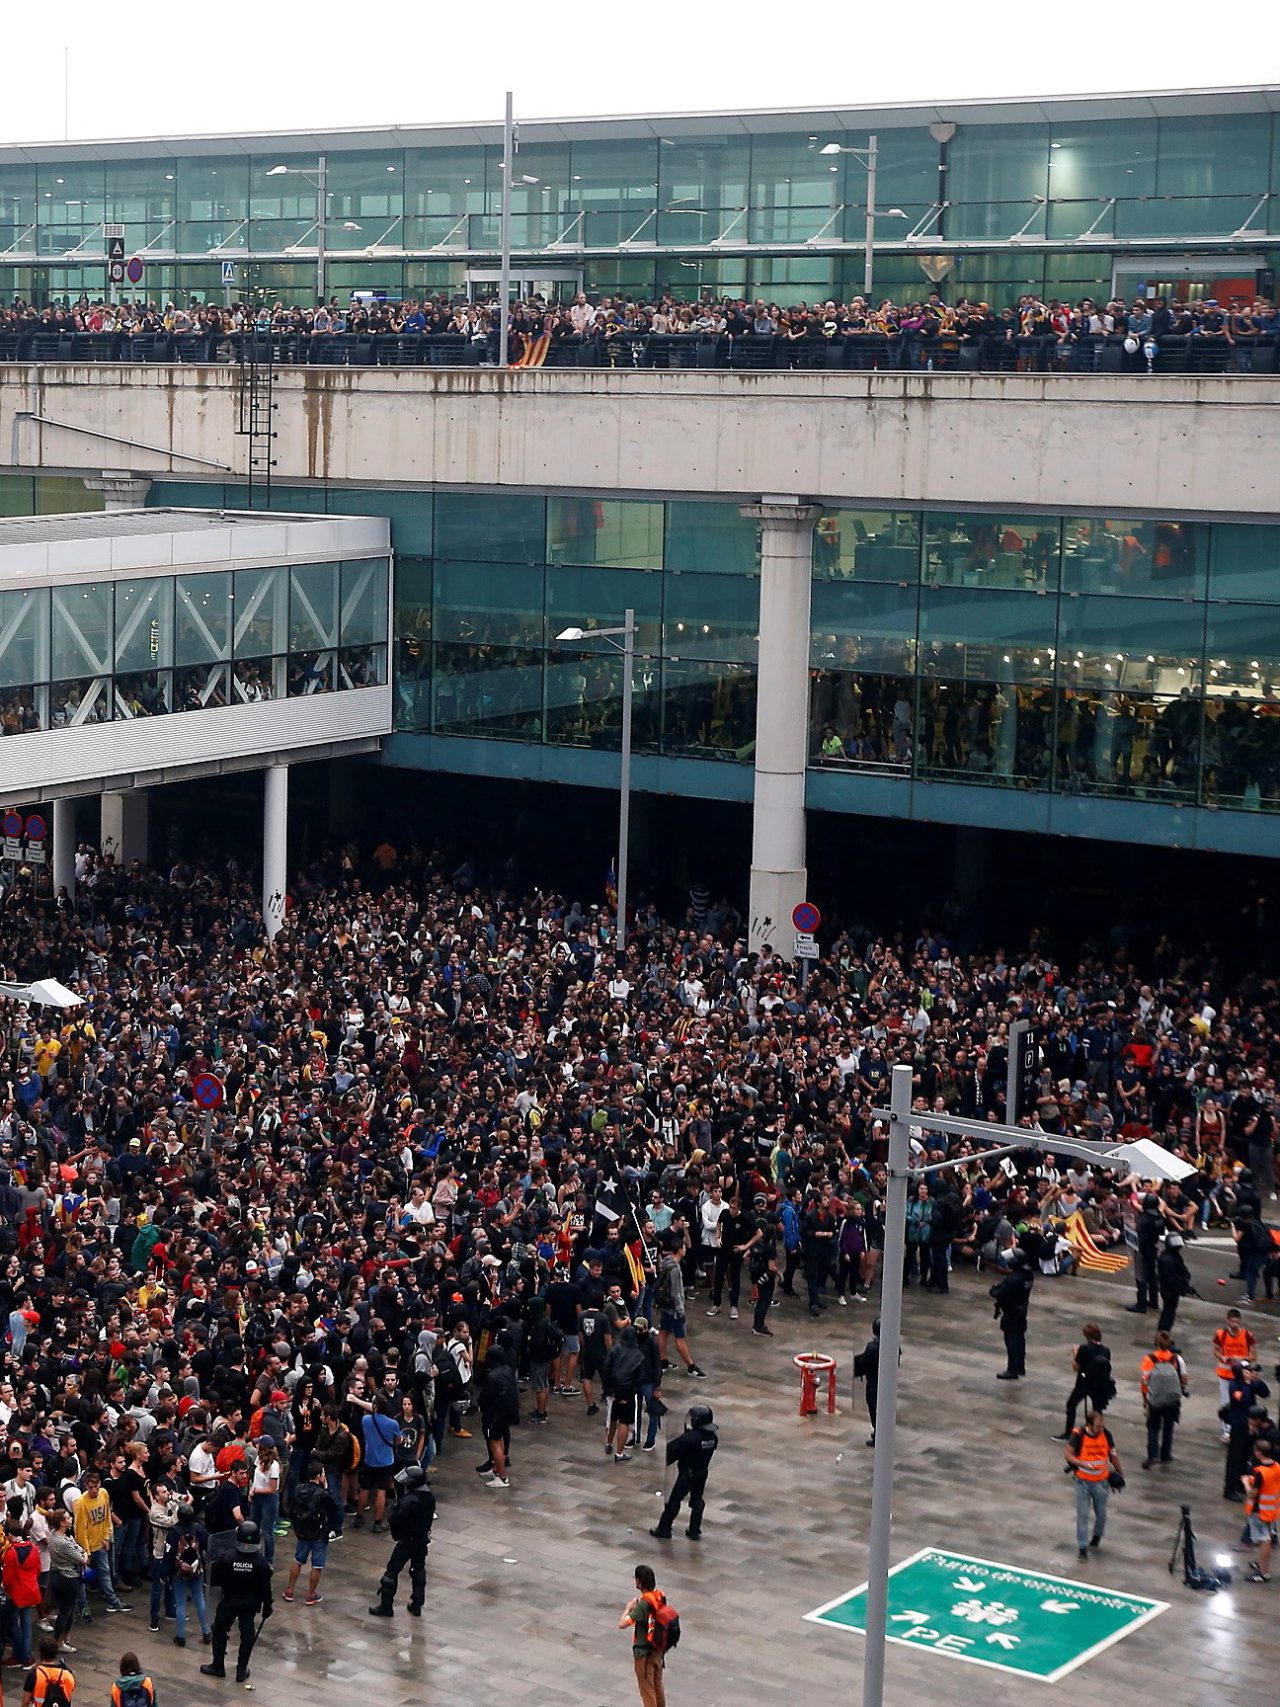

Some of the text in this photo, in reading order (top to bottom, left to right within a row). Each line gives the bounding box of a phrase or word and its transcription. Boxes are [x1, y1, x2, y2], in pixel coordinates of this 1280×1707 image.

[1026, 1032, 1034, 1045] T1
[233, 1561, 253, 1569] POLICIA
[921, 1553, 1148, 1614] Punto de encuentro
[901, 1625, 976, 1653] PE
